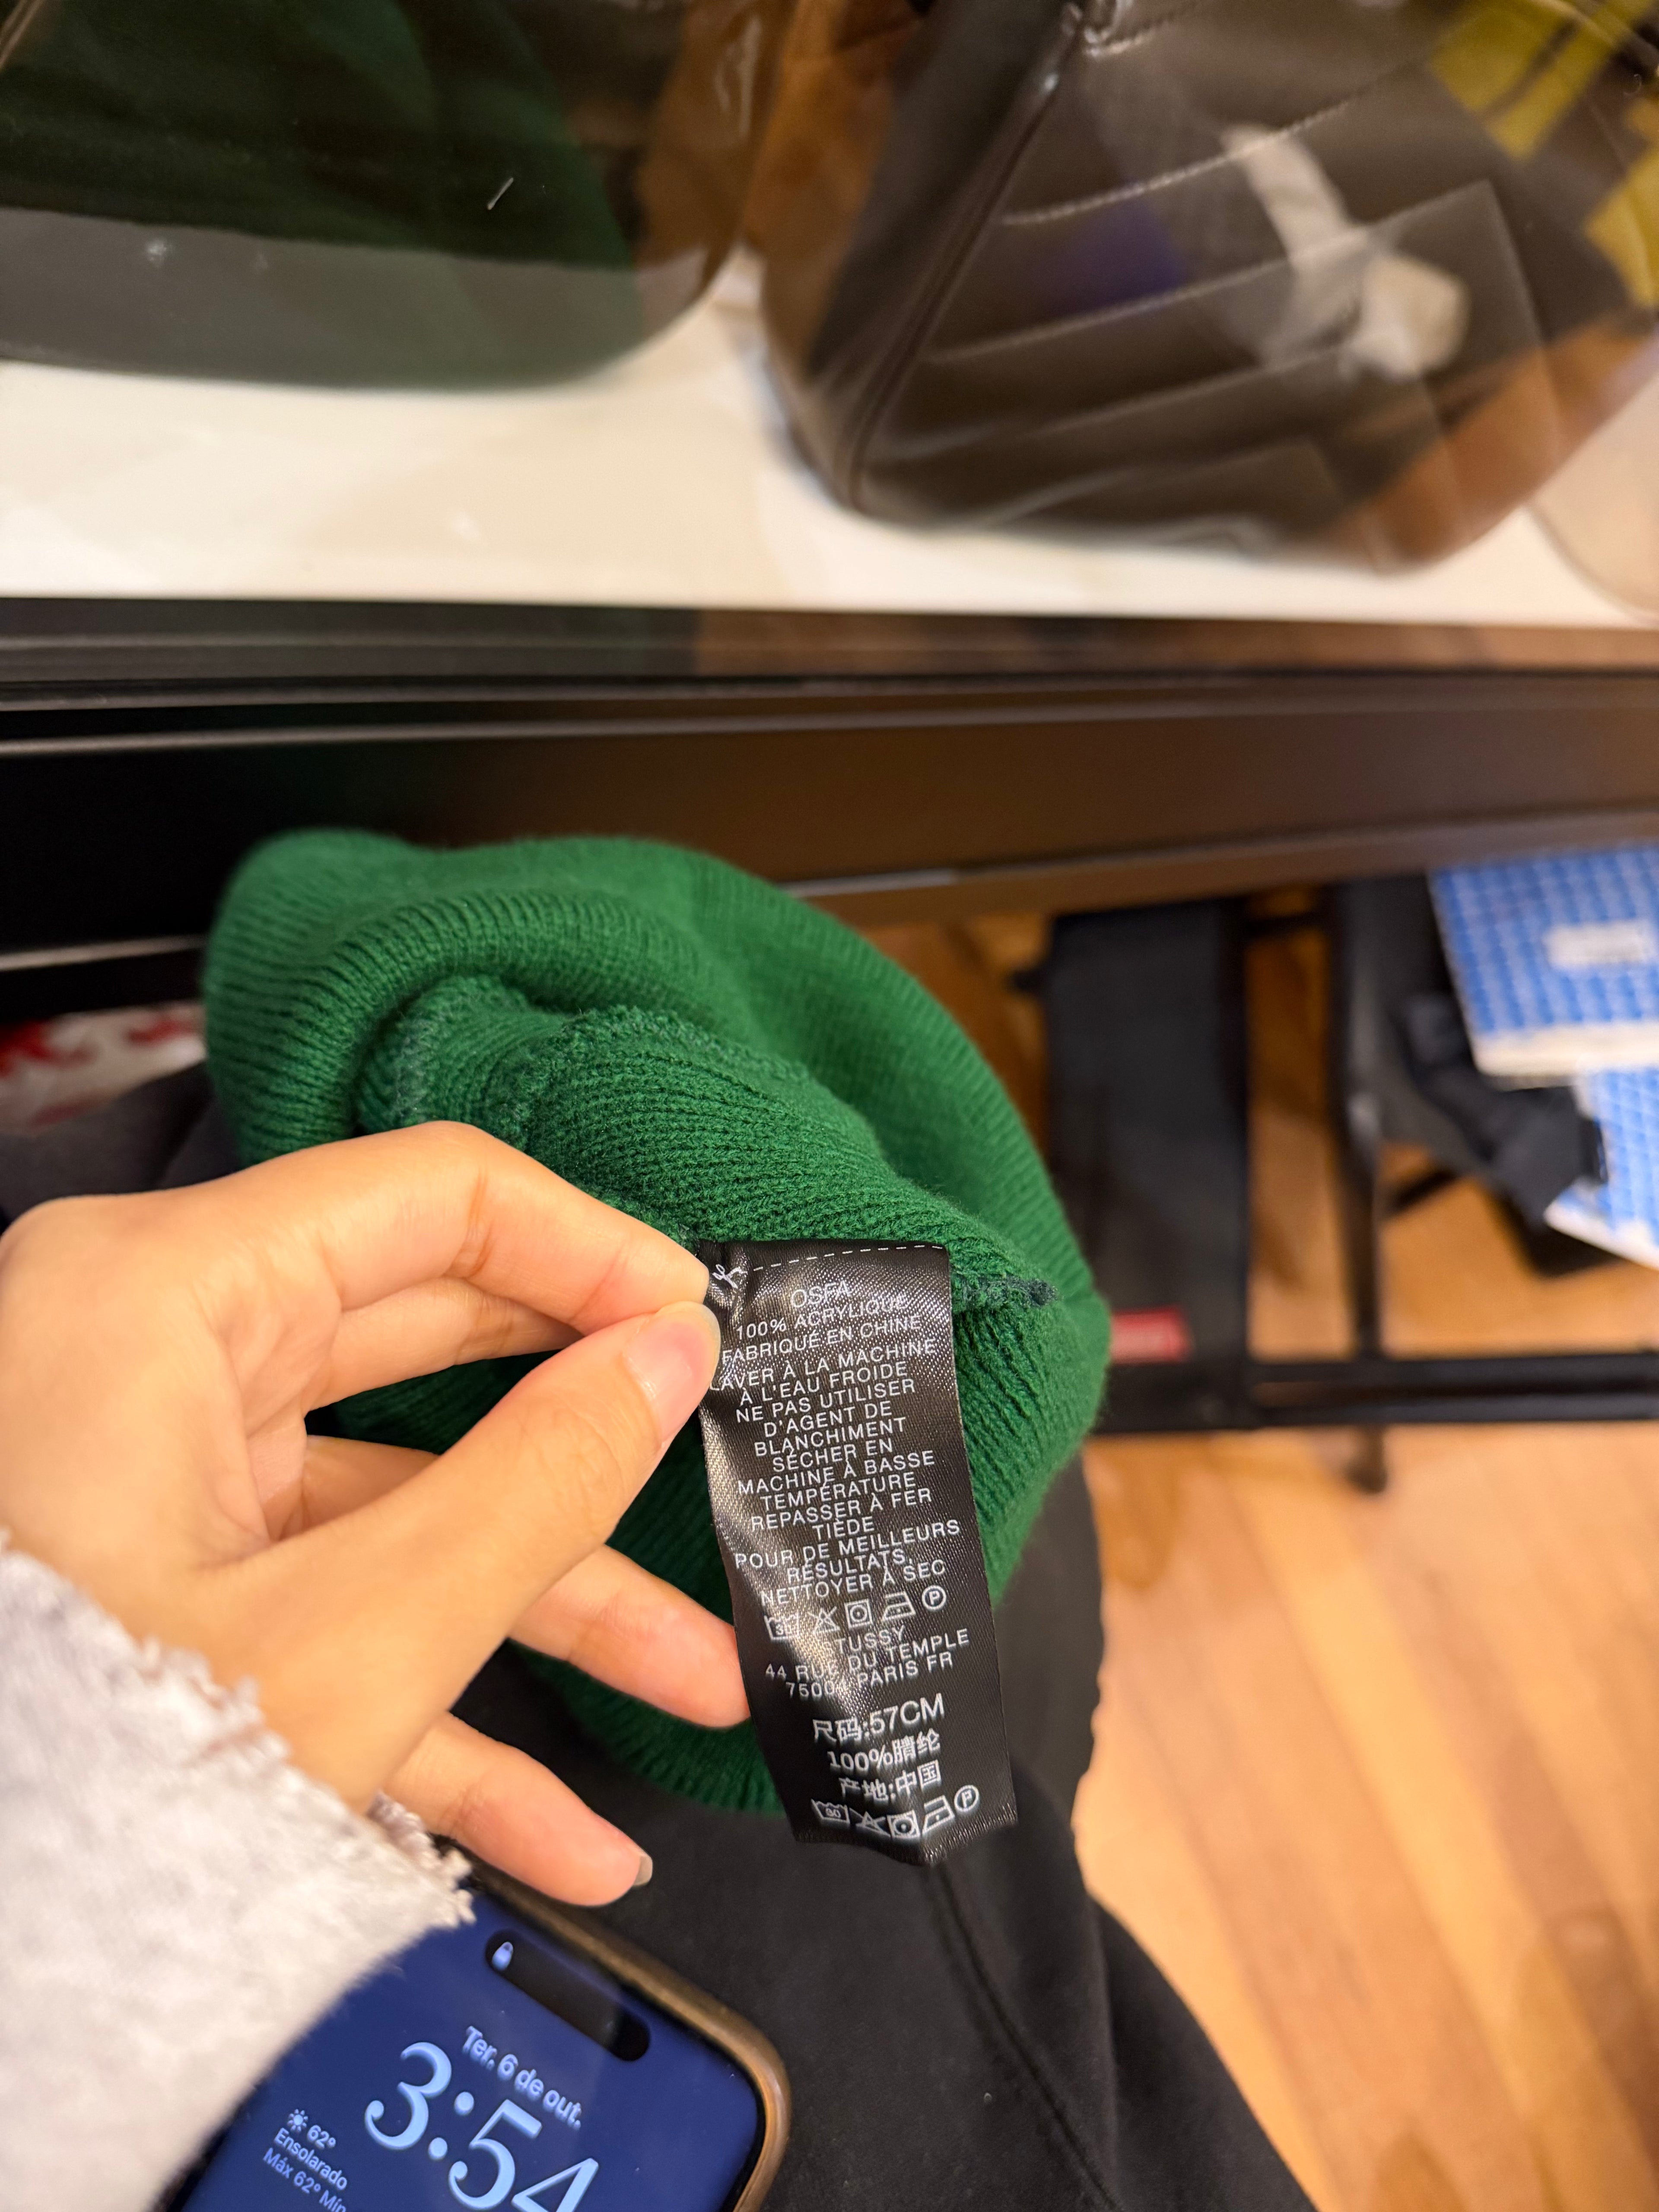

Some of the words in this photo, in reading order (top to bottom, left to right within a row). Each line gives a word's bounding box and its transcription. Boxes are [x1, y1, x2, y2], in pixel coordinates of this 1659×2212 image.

[791, 1280, 851, 1308] OSFA
[722, 1330, 819, 1364] FABRIQUÉ
[827, 1326, 852, 1344] EN
[860, 1315, 921, 1338] CHINE
[736, 1317, 787, 1340] 100%
[783, 1360, 796, 1380] À
[805, 1357, 830, 1375] LA
[838, 1339, 936, 1369] MACHINE
[736, 1406, 763, 1423] NE
[772, 1397, 811, 1417] PAS
[820, 1379, 915, 1408] UTILISER
[740, 1387, 753, 1406] À
[762, 1377, 820, 1401] L'EAU
[830, 1361, 907, 1388] FROIDE
[755, 1417, 906, 1456] BLANCHIMENT
[764, 1406, 855, 1437] D'AGENT
[864, 1400, 892, 1419] DE
[738, 1467, 836, 1494] MACHINE
[843, 1458, 857, 1479] À
[864, 1450, 934, 1475] BASSE
[773, 1444, 857, 1472] SÉCHER
[865, 1438, 893, 1456] EN
[751, 1500, 861, 1532] REPASSER
[870, 1493, 883, 1512] À
[891, 1488, 932, 1508] FER
[760, 1471, 916, 1511] TEMPÉRATURE
[735, 1550, 794, 1569] POUR
[803, 1542, 830, 1561] DE
[838, 1519, 960, 1555] MEILLEURS
[812, 1516, 874, 1541] TIÈDE
[761, 1573, 874, 1606] NETTOYER
[883, 1566, 895, 1586] À
[903, 1559, 945, 1582] SEC
[765, 1663, 787, 1681] 44
[848, 1651, 877, 1672] DU
[886, 1628, 969, 1662] TEMPLE
[857, 1660, 918, 1688] PARIS
[927, 1651, 953, 1672] FR
[462, 2026, 497, 2070] Ter.
[498, 2054, 518, 2080] 6
[514, 2069, 543, 2101] de
[543, 2090, 582, 2130] out.
[274, 2127, 347, 2190] Ensolarado
